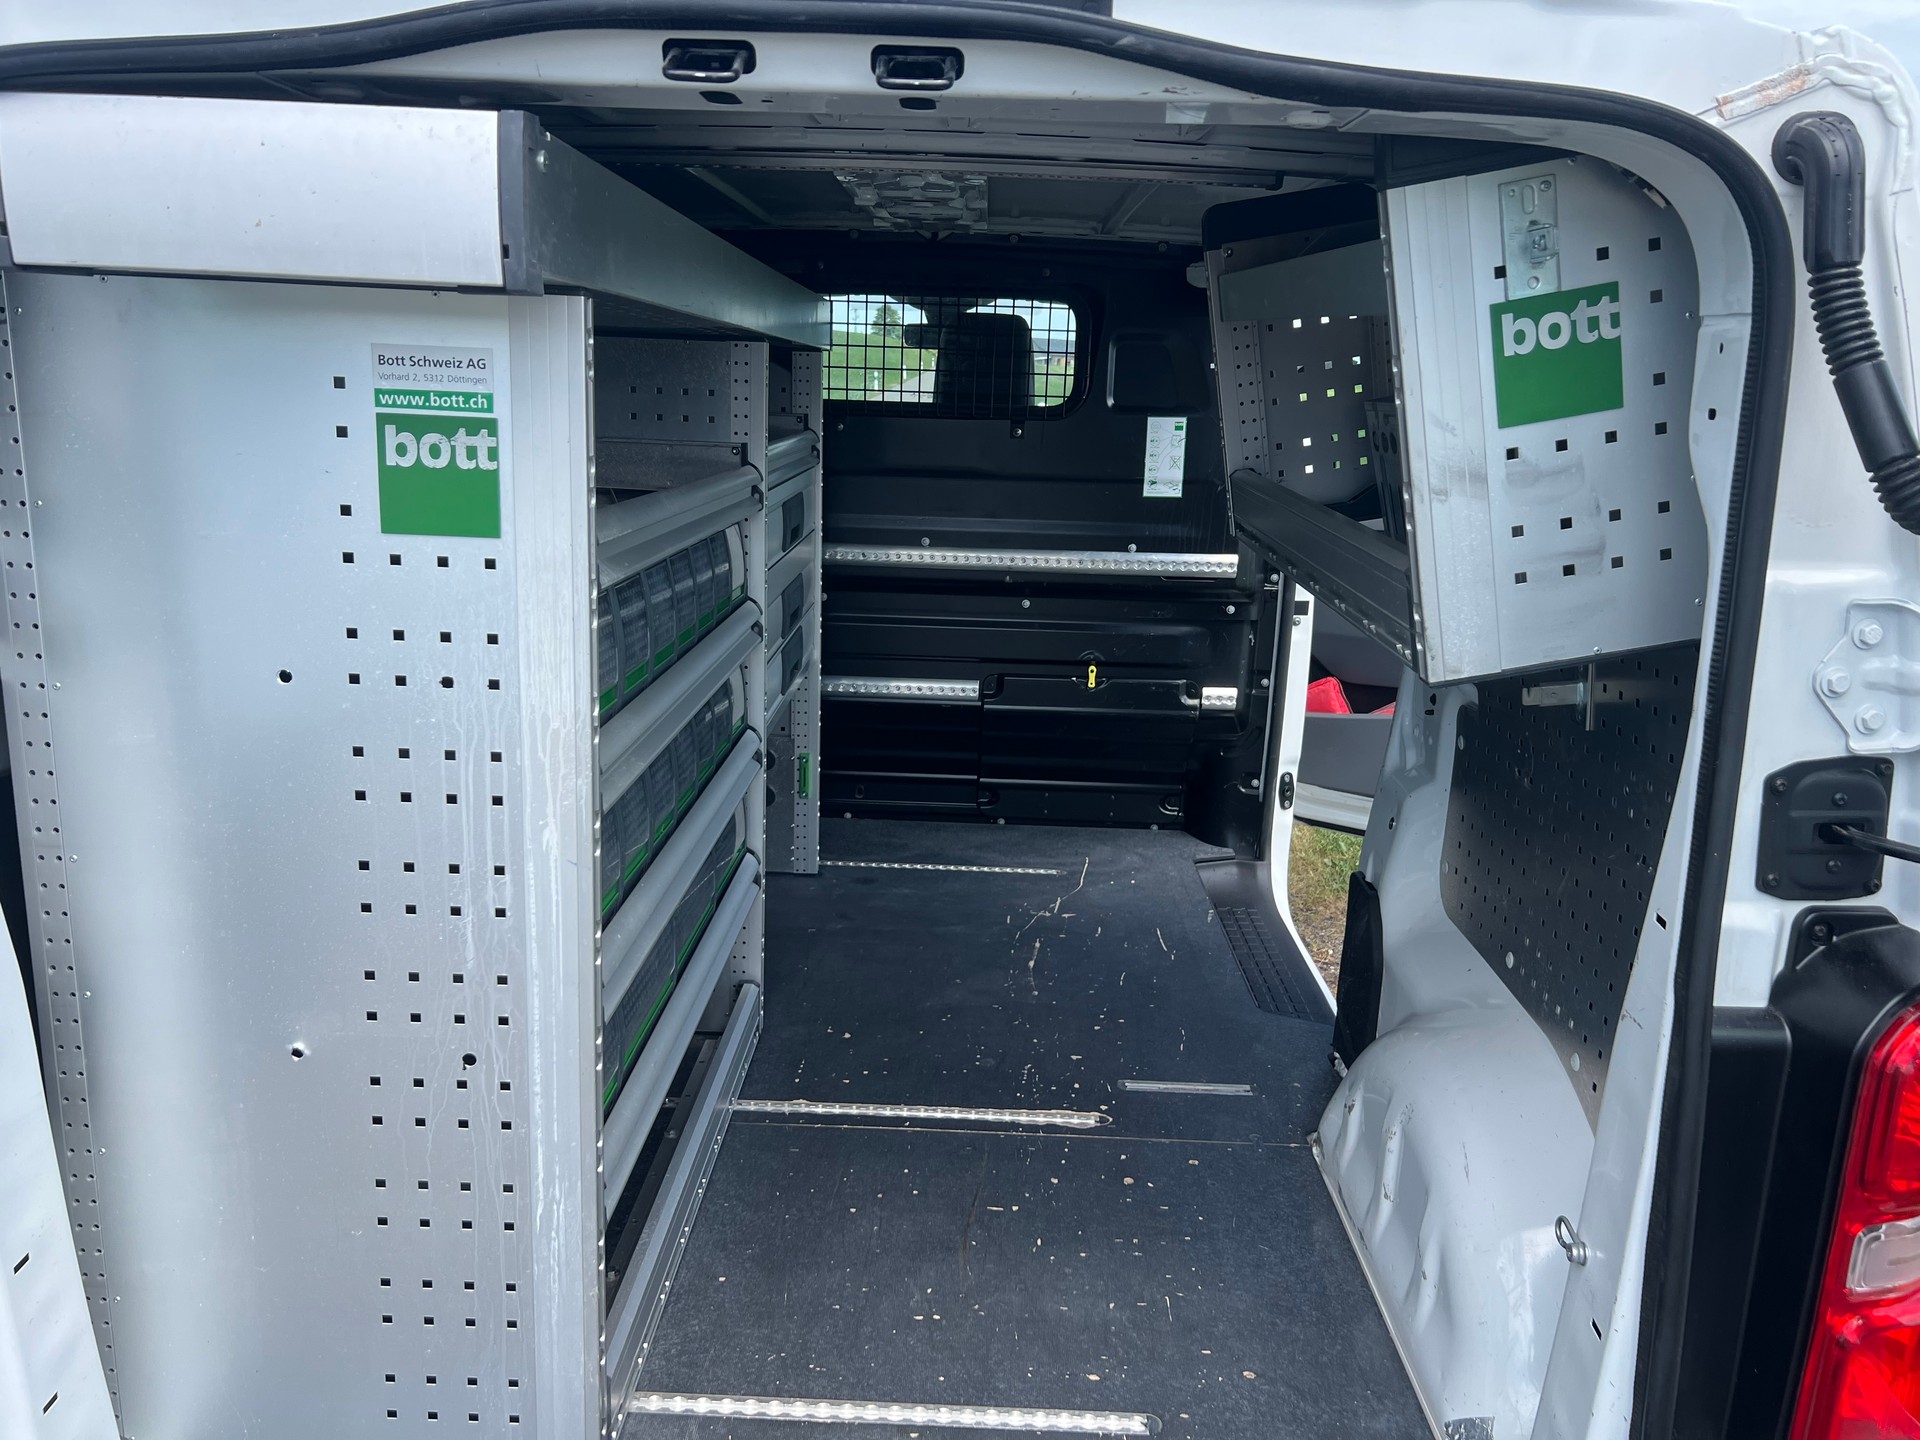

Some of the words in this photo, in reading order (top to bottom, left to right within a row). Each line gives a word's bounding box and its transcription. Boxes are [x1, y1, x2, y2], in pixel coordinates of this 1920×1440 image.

[1501, 295, 1621, 357] bott
[378, 354, 406, 367] Bott
[409, 355, 464, 369] Schweiz
[466, 358, 487, 370] AG
[378, 372, 410, 381] Vorhard
[412, 373, 421, 383] 2,
[423, 374, 445, 383] 5312
[447, 374, 488, 386] Döttingen
[379, 392, 488, 409] www.bott.ch
[384, 424, 498, 471] bott
